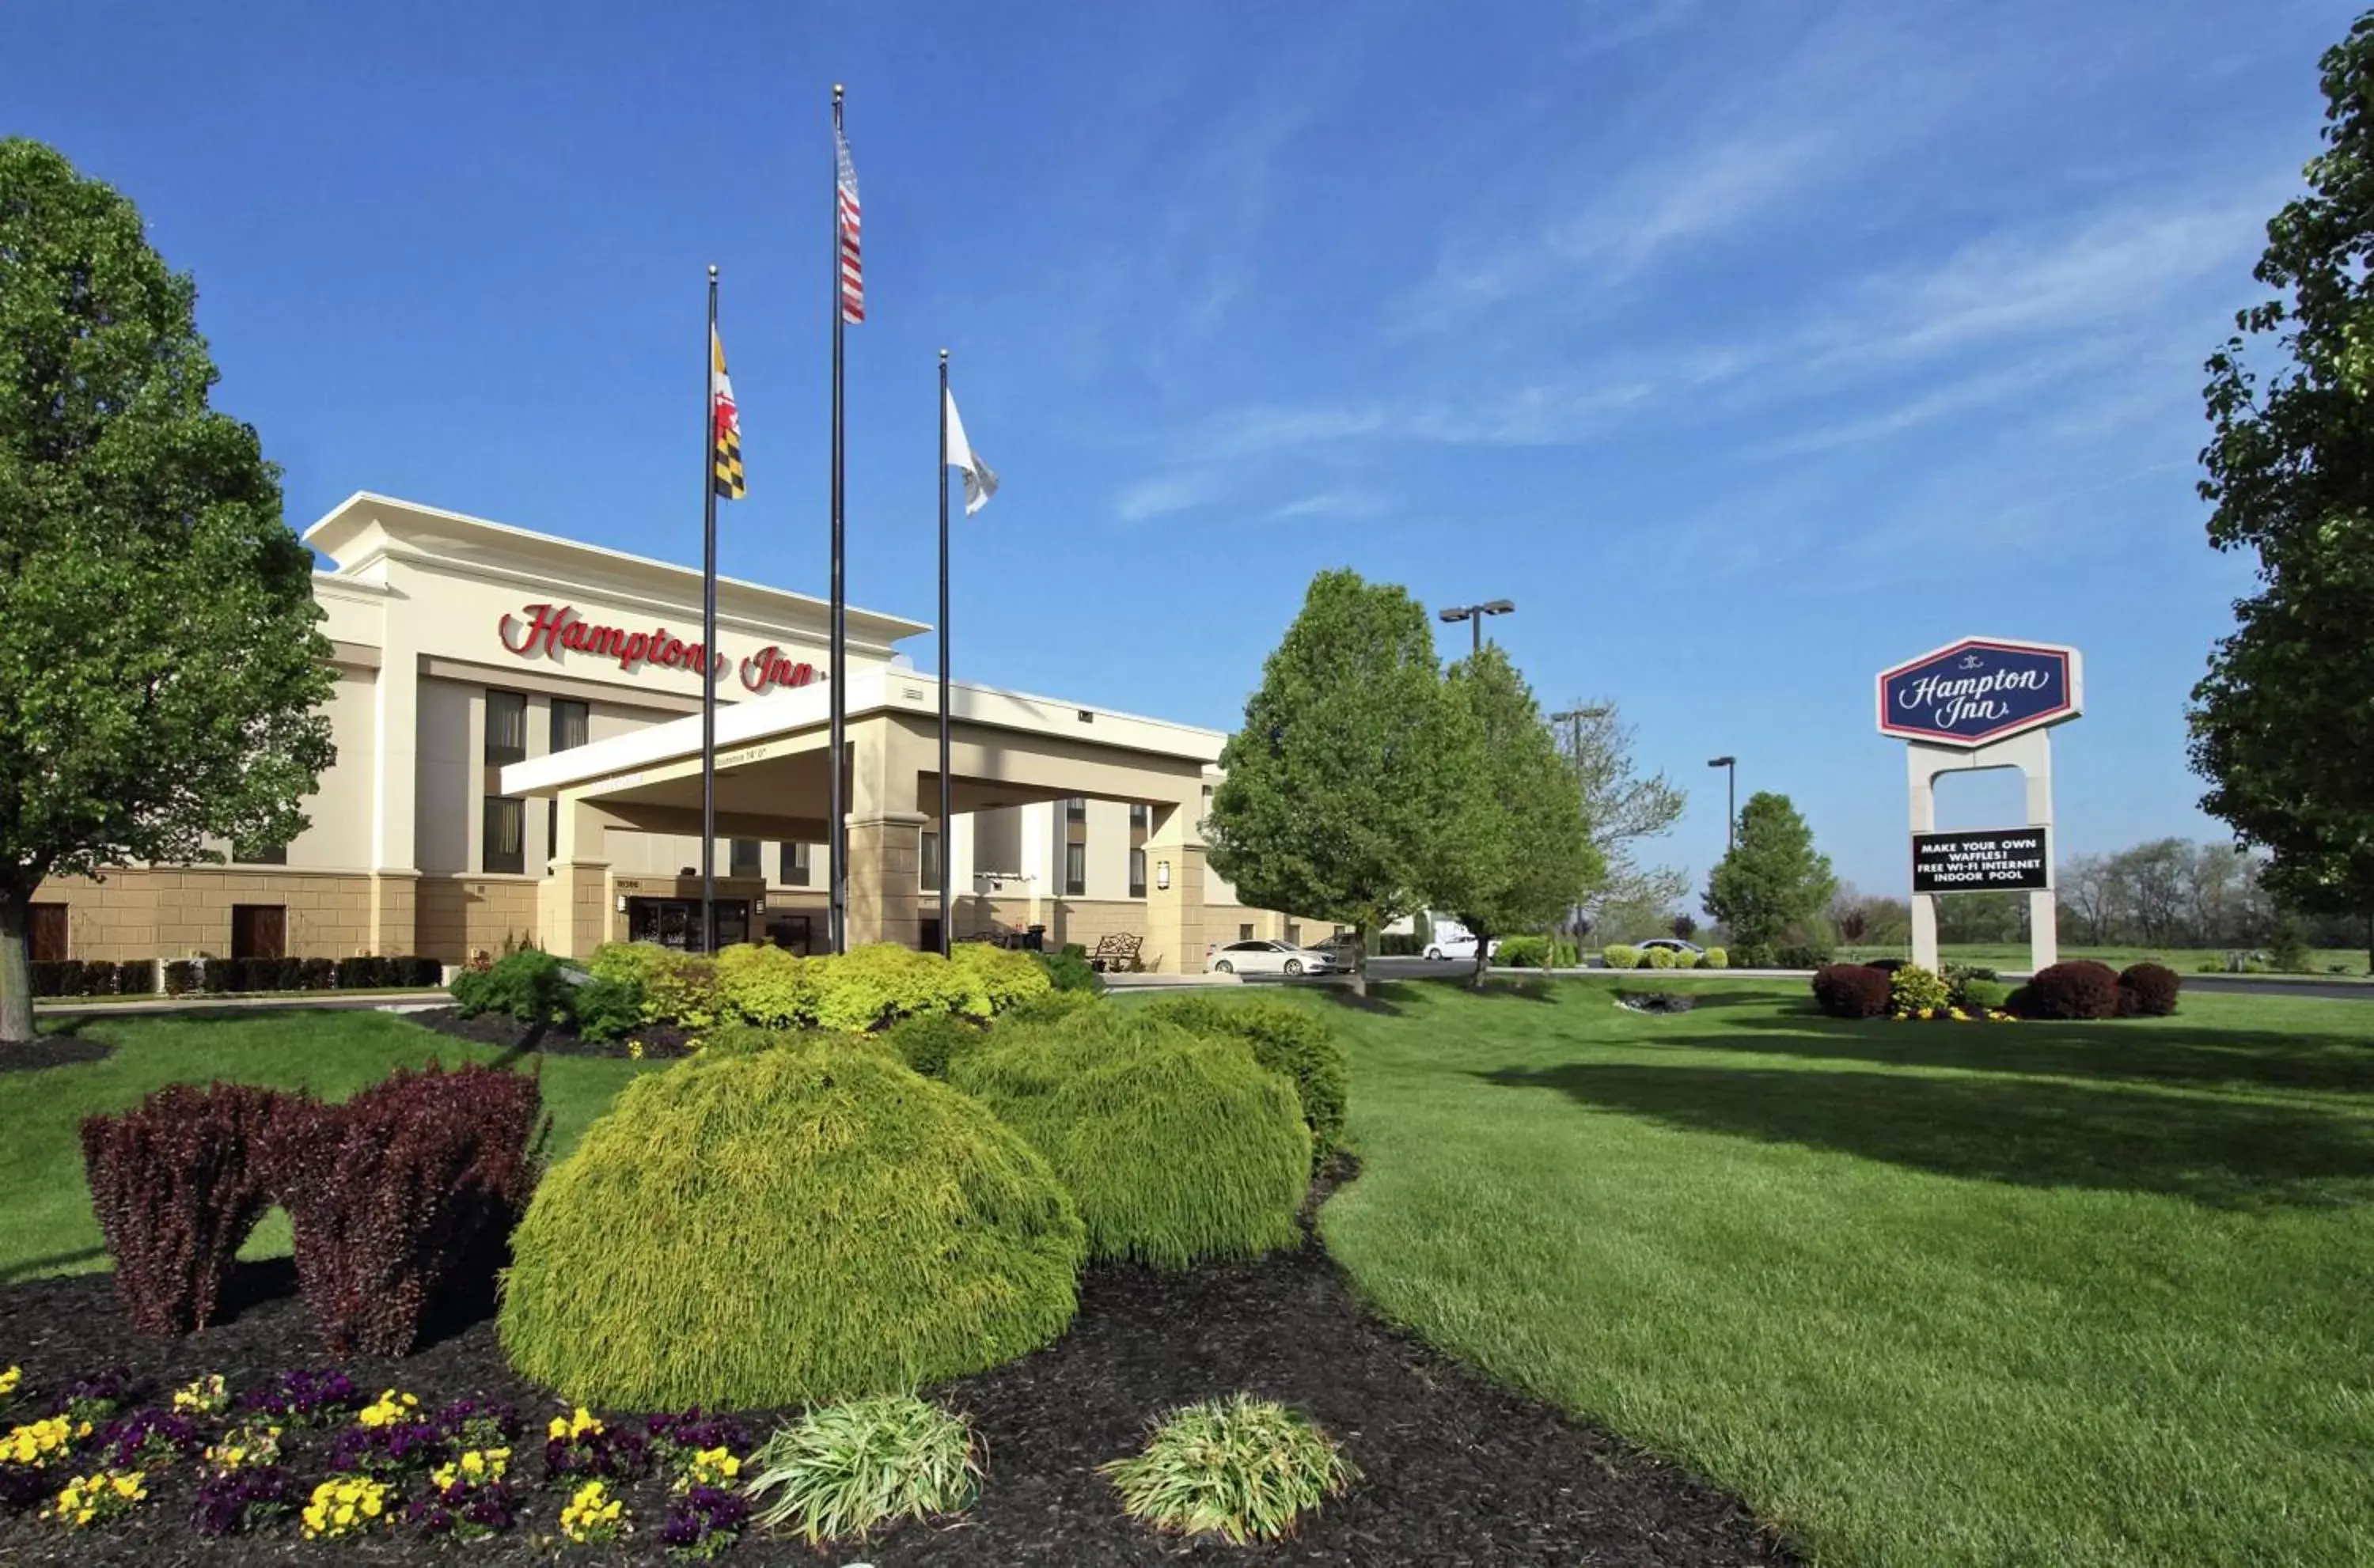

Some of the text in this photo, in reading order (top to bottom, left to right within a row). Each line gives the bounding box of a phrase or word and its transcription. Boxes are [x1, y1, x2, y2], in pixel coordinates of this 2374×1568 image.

[499, 604, 826, 691] Hampton Inn
[1899, 668, 2049, 710] Hampton
[1936, 696, 2008, 729] Inn
[1921, 839, 2036, 854] MAKE YOUR OWN
[1917, 859, 2041, 873] FREE WI-FI INTERNET
[1934, 870, 2023, 882] INDOOR POOL
